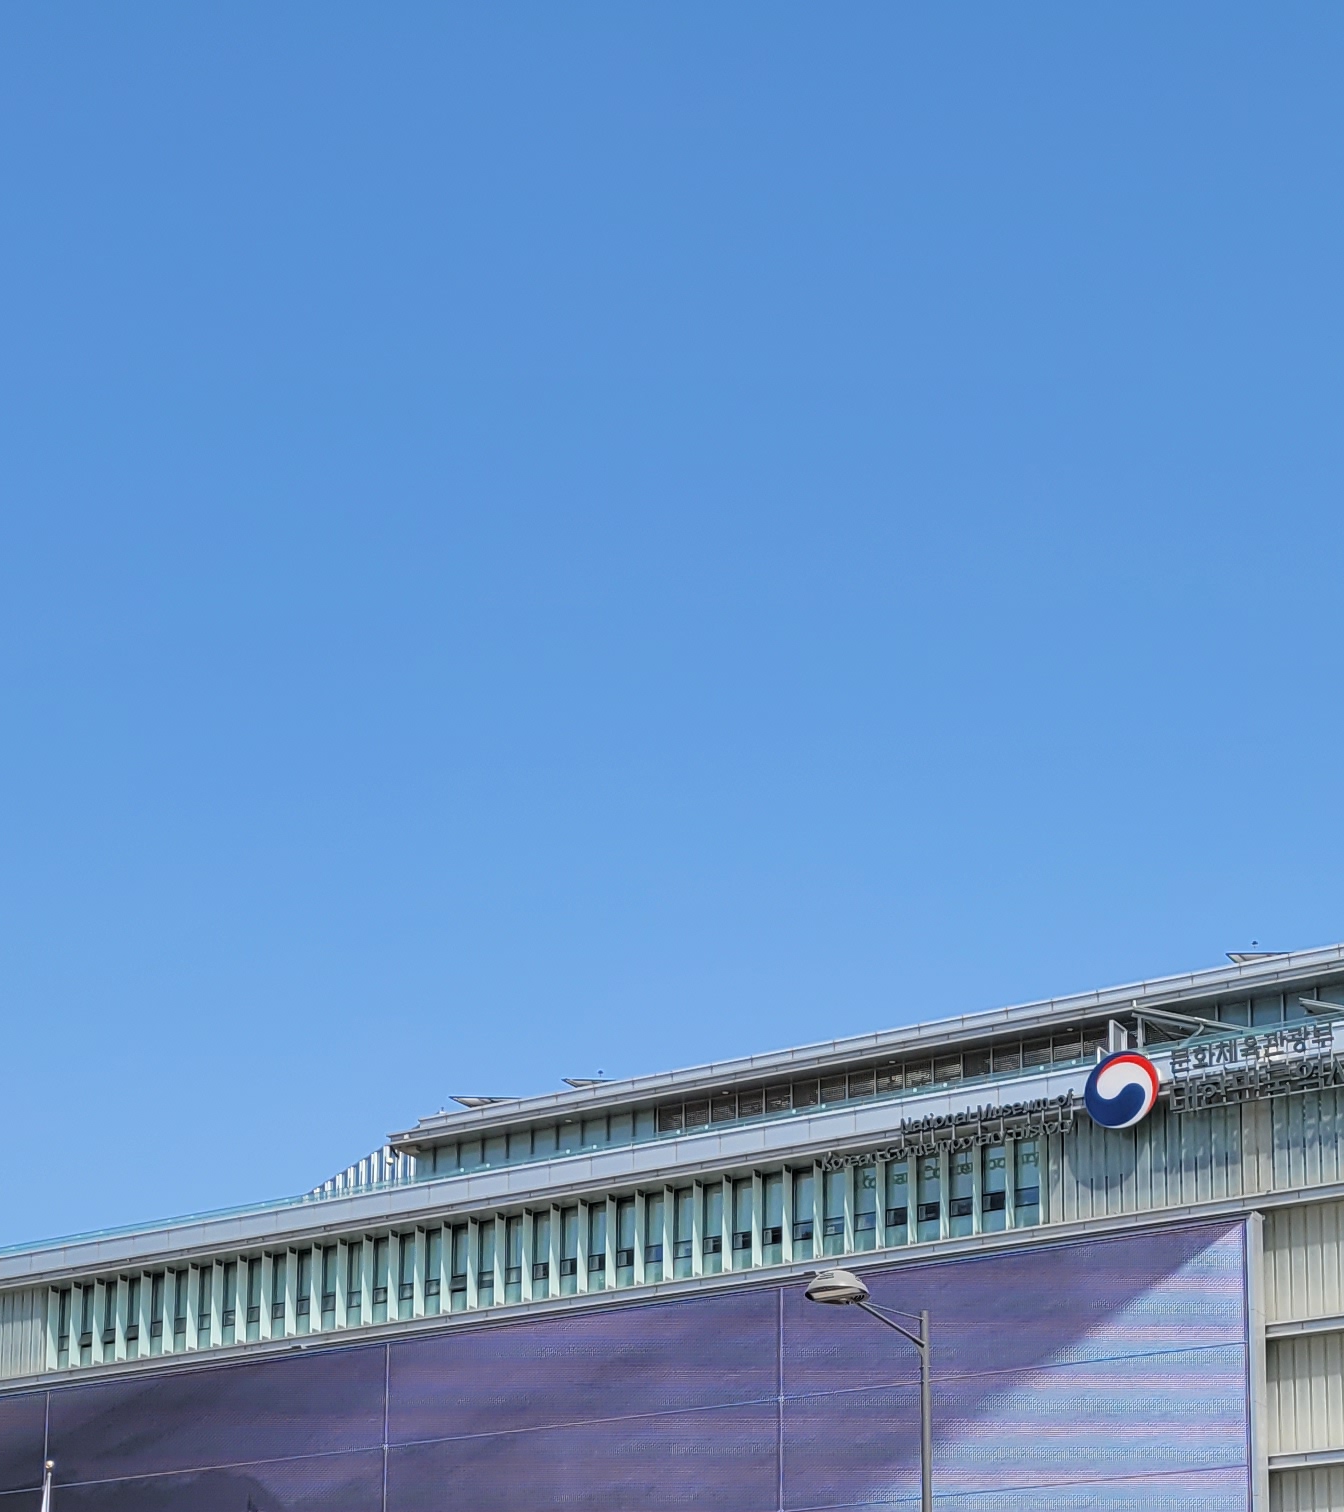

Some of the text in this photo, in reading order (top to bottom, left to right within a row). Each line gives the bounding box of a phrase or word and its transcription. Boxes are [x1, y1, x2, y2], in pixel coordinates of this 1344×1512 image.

[1170, 1025, 1334, 1072] 문화체육관광부
[900, 1088, 1074, 1134] National Museum of
[884, 1130, 1005, 1161] Contemporary
[1006, 1118, 1074, 1142] History
